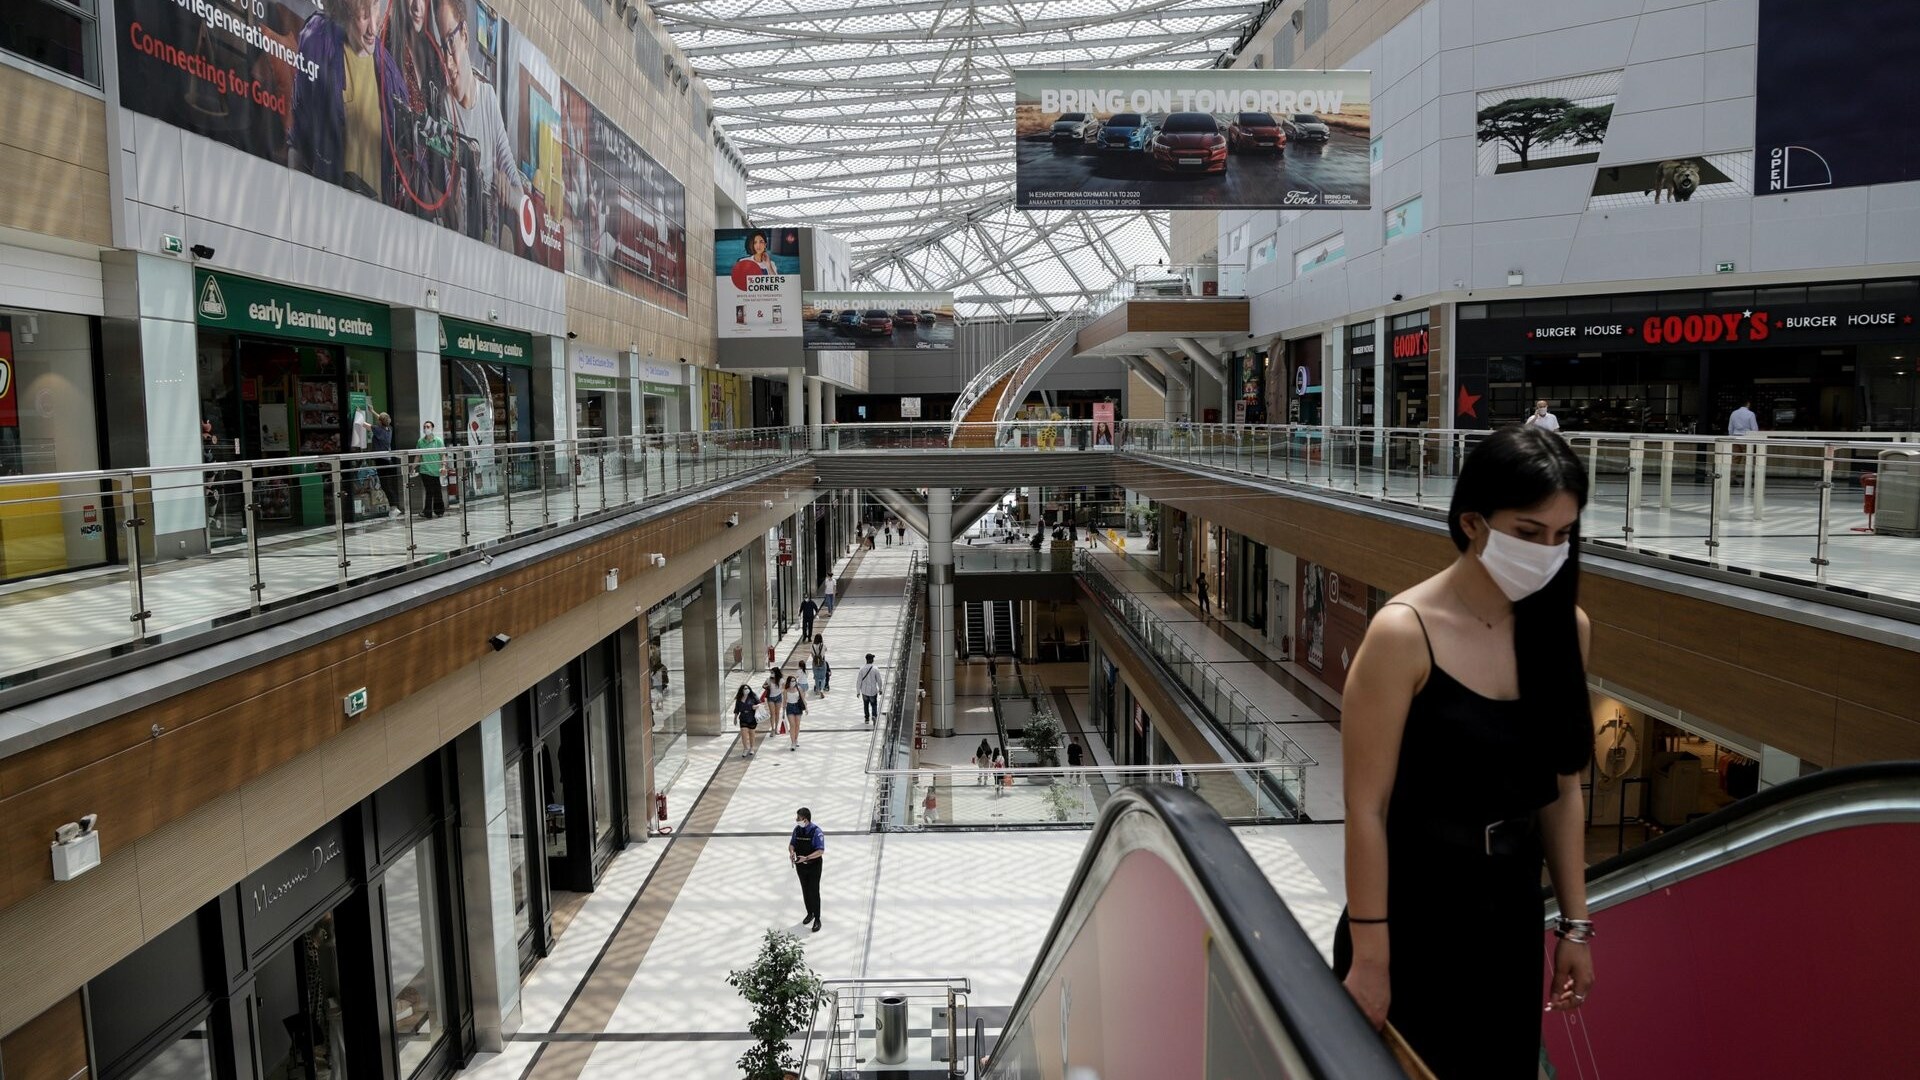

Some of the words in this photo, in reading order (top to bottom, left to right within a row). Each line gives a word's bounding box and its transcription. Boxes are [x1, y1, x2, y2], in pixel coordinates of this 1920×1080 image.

[130, 22, 226, 94] Connecting
[229, 69, 249, 98] for
[252, 80, 286, 115] Good
[1041, 89, 1127, 114] BRING
[1130, 89, 1171, 114] ON
[1177, 89, 1344, 114] TOMORROW
[1770, 147, 1782, 190] OPEN
[1283, 190, 1318, 205] Ford
[814, 300, 849, 310] BRING
[851, 300, 869, 310] ON
[870, 300, 942, 310] TOMORROW
[249, 299, 284, 329] early
[286, 302, 336, 337] learning
[339, 318, 373, 336] centre
[1786, 315, 1837, 329] BURGER
[1848, 313, 1895, 326] HOUSE
[1536, 326, 1577, 338] BURGER
[1584, 325, 1622, 336] HOUSE
[458, 333, 476, 354] early
[476, 334, 504, 359] learning
[504, 344, 523, 357] centre
[254, 867, 308, 917] Massimo
